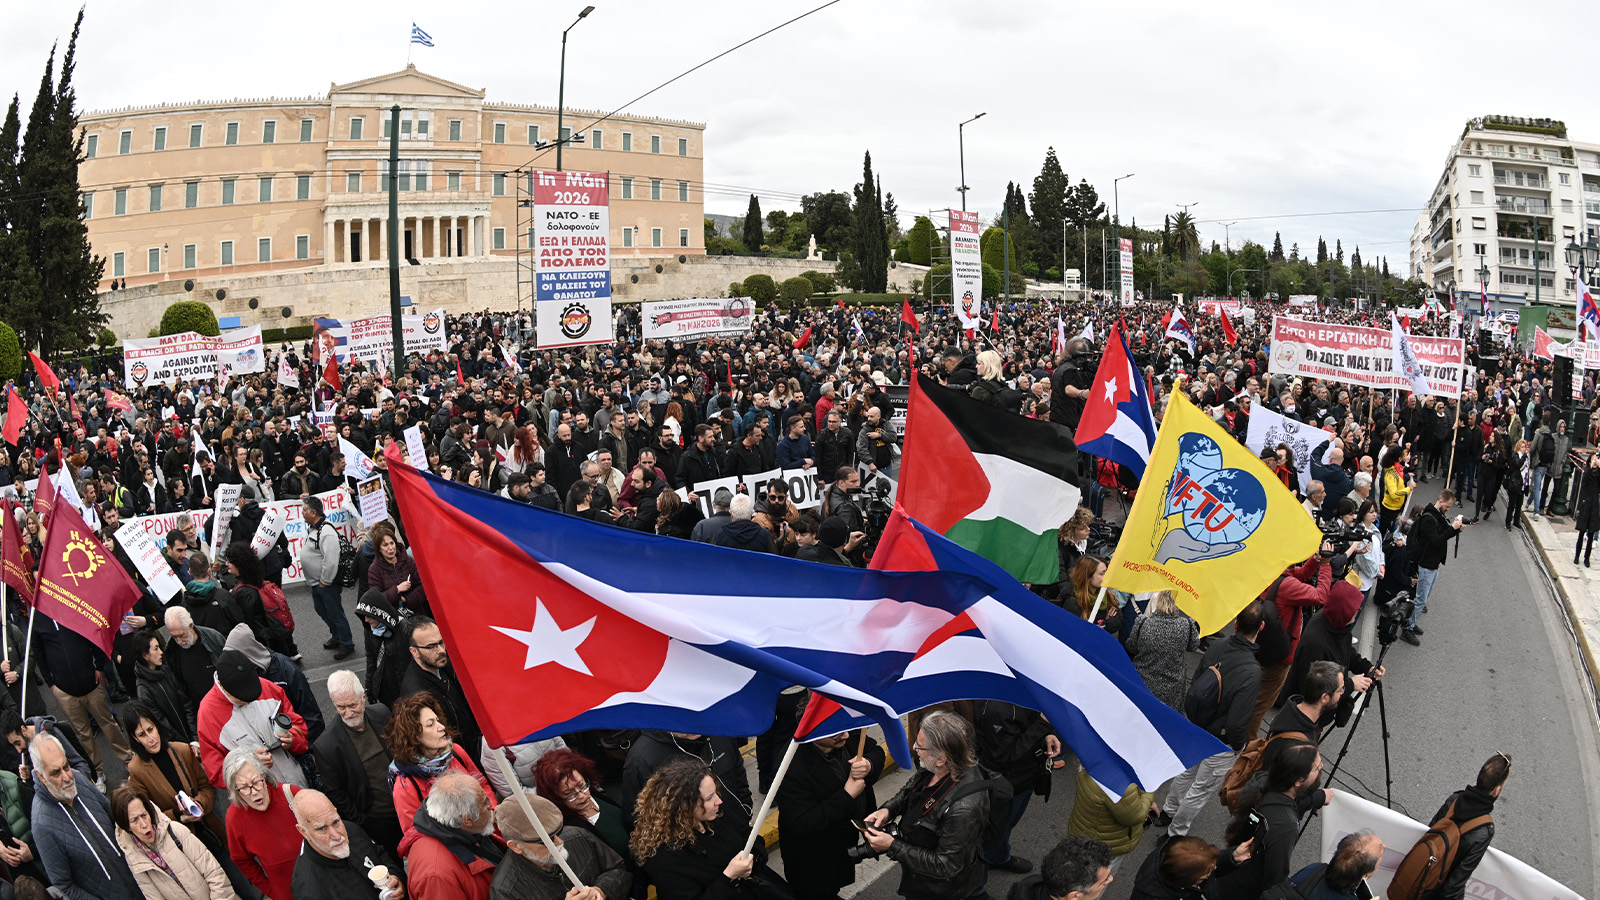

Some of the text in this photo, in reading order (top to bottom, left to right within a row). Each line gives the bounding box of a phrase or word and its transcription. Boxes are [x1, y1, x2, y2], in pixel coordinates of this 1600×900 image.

[553, 191, 591, 205] 2026
[546, 211, 579, 220] ΝΑΤΟ
[589, 212, 600, 220] ΕΕ
[547, 221, 600, 232] δολοφονούν
[960, 224, 973, 233] 2026
[539, 236, 607, 246] ΕΞΩ Η ΕΛΛΑΔΑ
[540, 248, 606, 257] ΑΠΟ ΤΟΝ
[541, 257, 607, 268] ΠΟΛΕΜΟ
[541, 271, 606, 281] ΝΑ ΚΛΕΙΣΟΥΝ
[541, 280, 607, 291] ΟΙ ΒΑΣΕΙΣ ΤΟΥ
[553, 290, 597, 301] ΘΑΝΑΤΟΥ
[351, 320, 366, 328] 100
[700, 318, 721, 328] 2026
[160, 335, 178, 345] MAY
[181, 333, 198, 342] DAY
[1279, 325, 1306, 338] ΖΗΤΩ
[1308, 330, 1316, 340] Η
[1318, 329, 1377, 347] ΕΡΓΑΤΙΚΗ
[1381, 336, 1459, 357] ΠΤΟΜΑΓΙΑ
[128, 336, 257, 359] WE MARCH ON THE PATH OF OVERTHROW
[162, 355, 199, 368] AGAINST
[1306, 349, 1317, 362] ΟΙ
[1319, 351, 1345, 368] ΖΩΕΣ
[1347, 355, 1370, 371] ΜΑΣ
[1434, 366, 1458, 382] ΤΟΥΣ
[153, 363, 233, 380] AND EXPLOITATN
[1433, 383, 1437, 391] &
[1438, 384, 1458, 394] ΠΟΤΩΝ
[142, 514, 180, 537] ΡΟΝΙ
[1175, 578, 1200, 600] UNIONS
